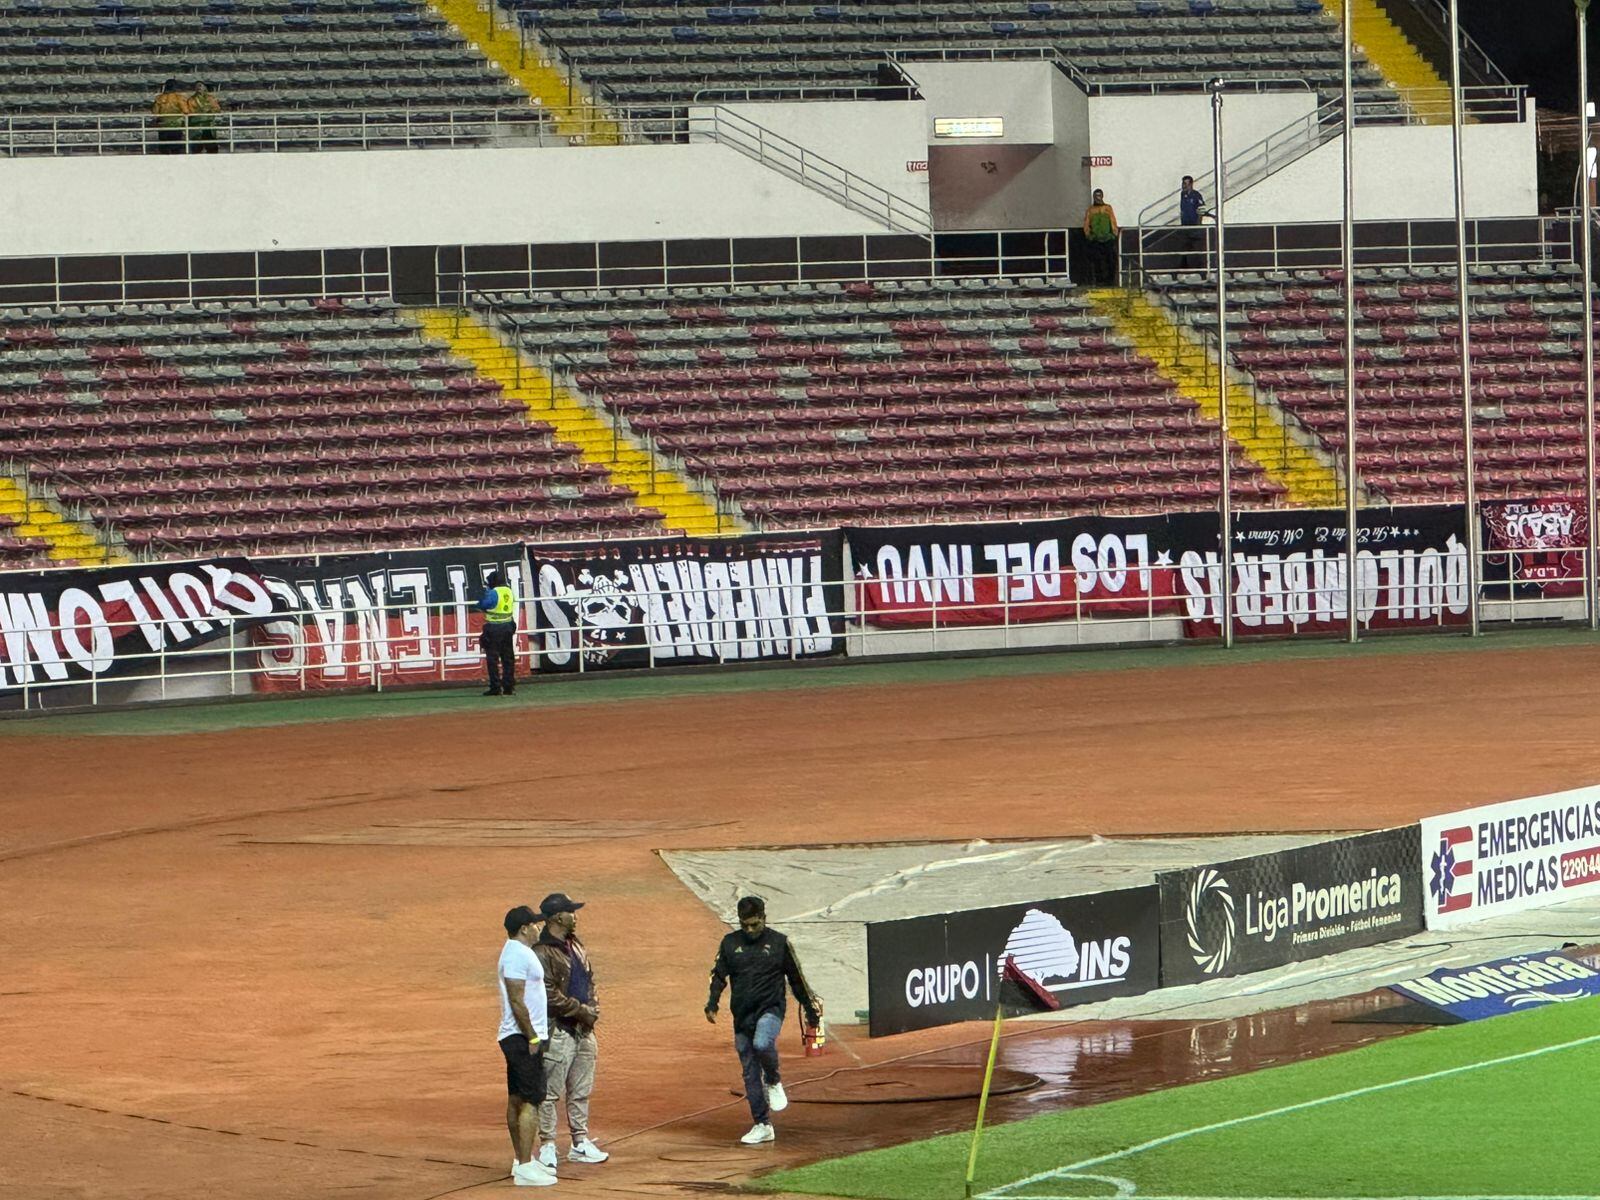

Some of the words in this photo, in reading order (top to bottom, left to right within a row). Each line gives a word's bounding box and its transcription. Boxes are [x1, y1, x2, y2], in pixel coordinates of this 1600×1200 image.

[876, 544, 974, 604] INVU
[984, 538, 1061, 602] DEL
[1071, 532, 1150, 593] LOS
[1524, 566, 1557, 578] L.D.A
[1246, 891, 1289, 942] Liga
[1292, 867, 1401, 925] Promerica
[1477, 855, 1559, 907] MÉDICAS
[1079, 936, 1131, 981] INS
[1293, 929, 1319, 945] Primera
[1319, 924, 1345, 939] División
[905, 960, 979, 1008] GRUPO
[1398, 955, 1599, 1006] Montaña
